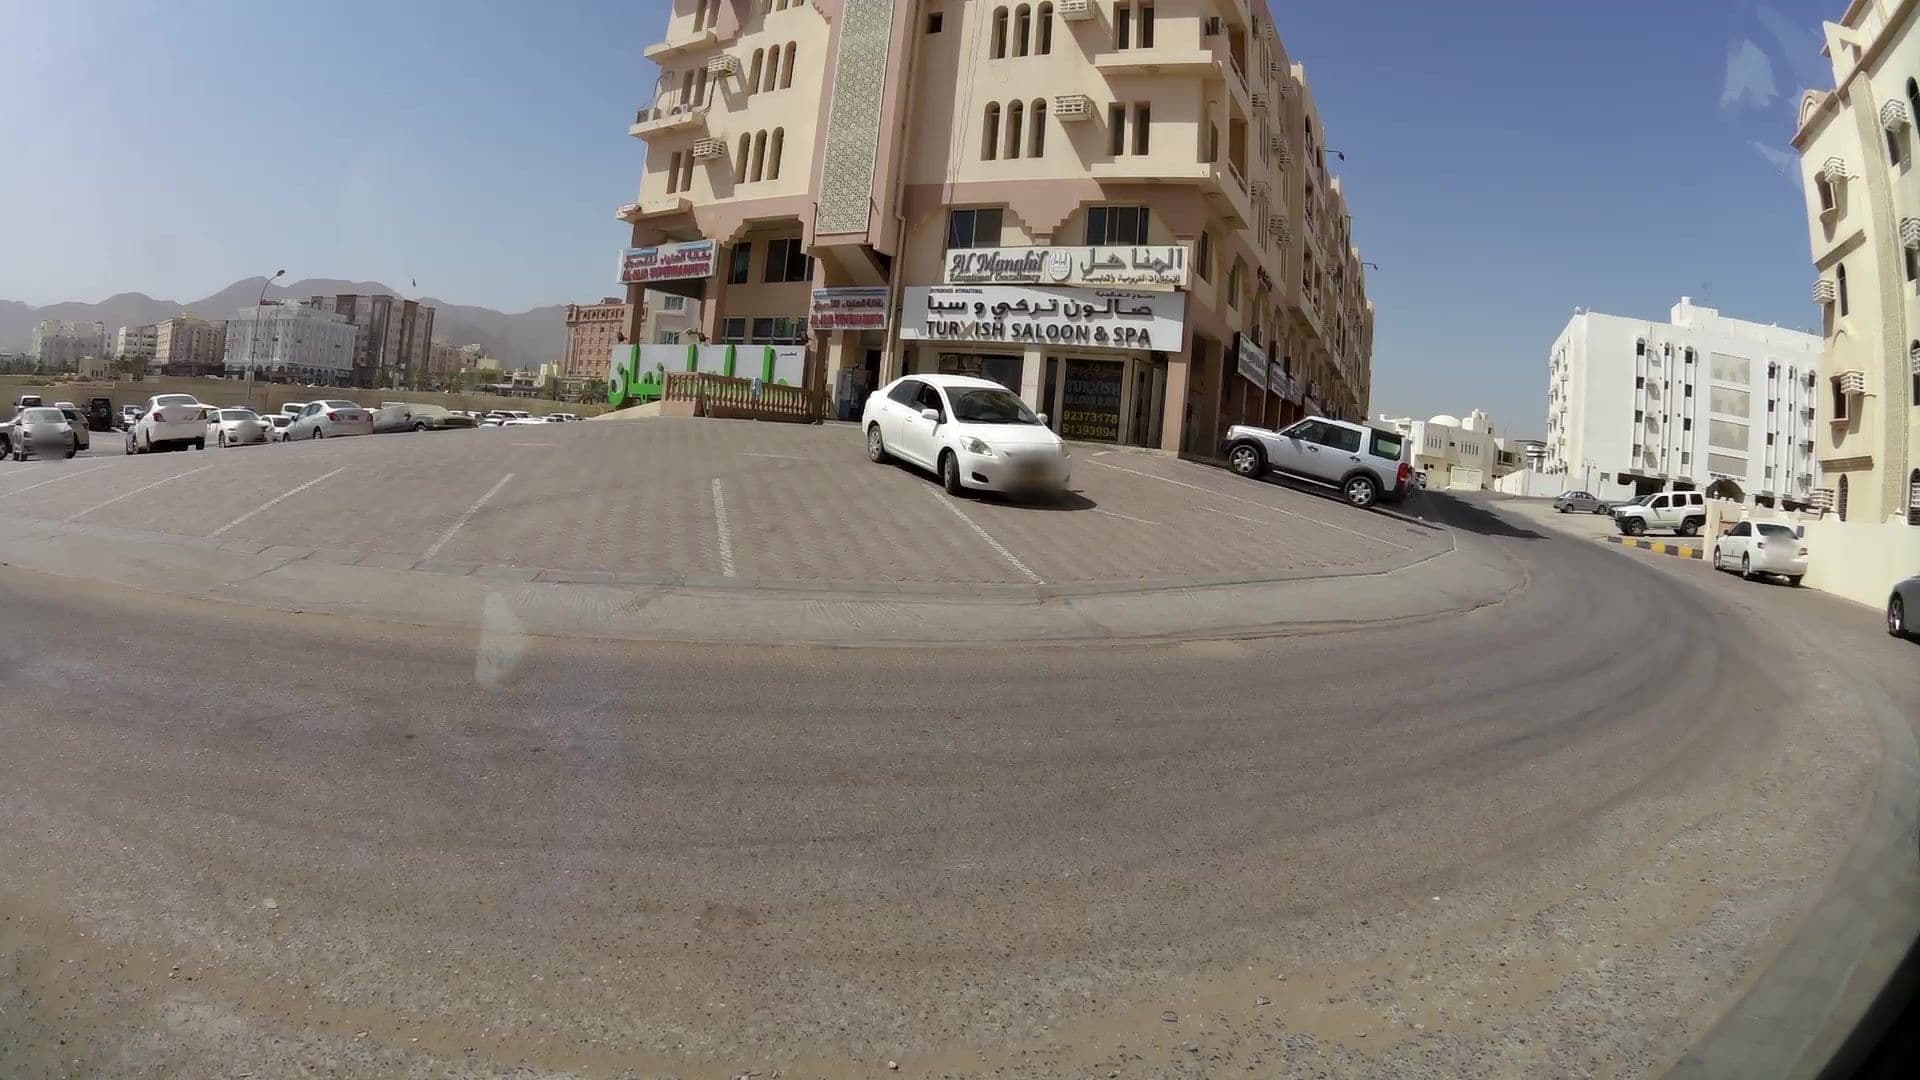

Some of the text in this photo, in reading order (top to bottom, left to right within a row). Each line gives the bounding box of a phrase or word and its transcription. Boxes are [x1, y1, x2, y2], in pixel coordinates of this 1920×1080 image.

[950, 249, 1049, 273] Al Manahil
[1080, 247, 1182, 275] المناهل
[927, 295, 1152, 320] صالون تركي و سبا
[1011, 322, 1088, 340] SALOON
[1094, 325, 1108, 341] &
[1113, 326, 1151, 344] SPA
